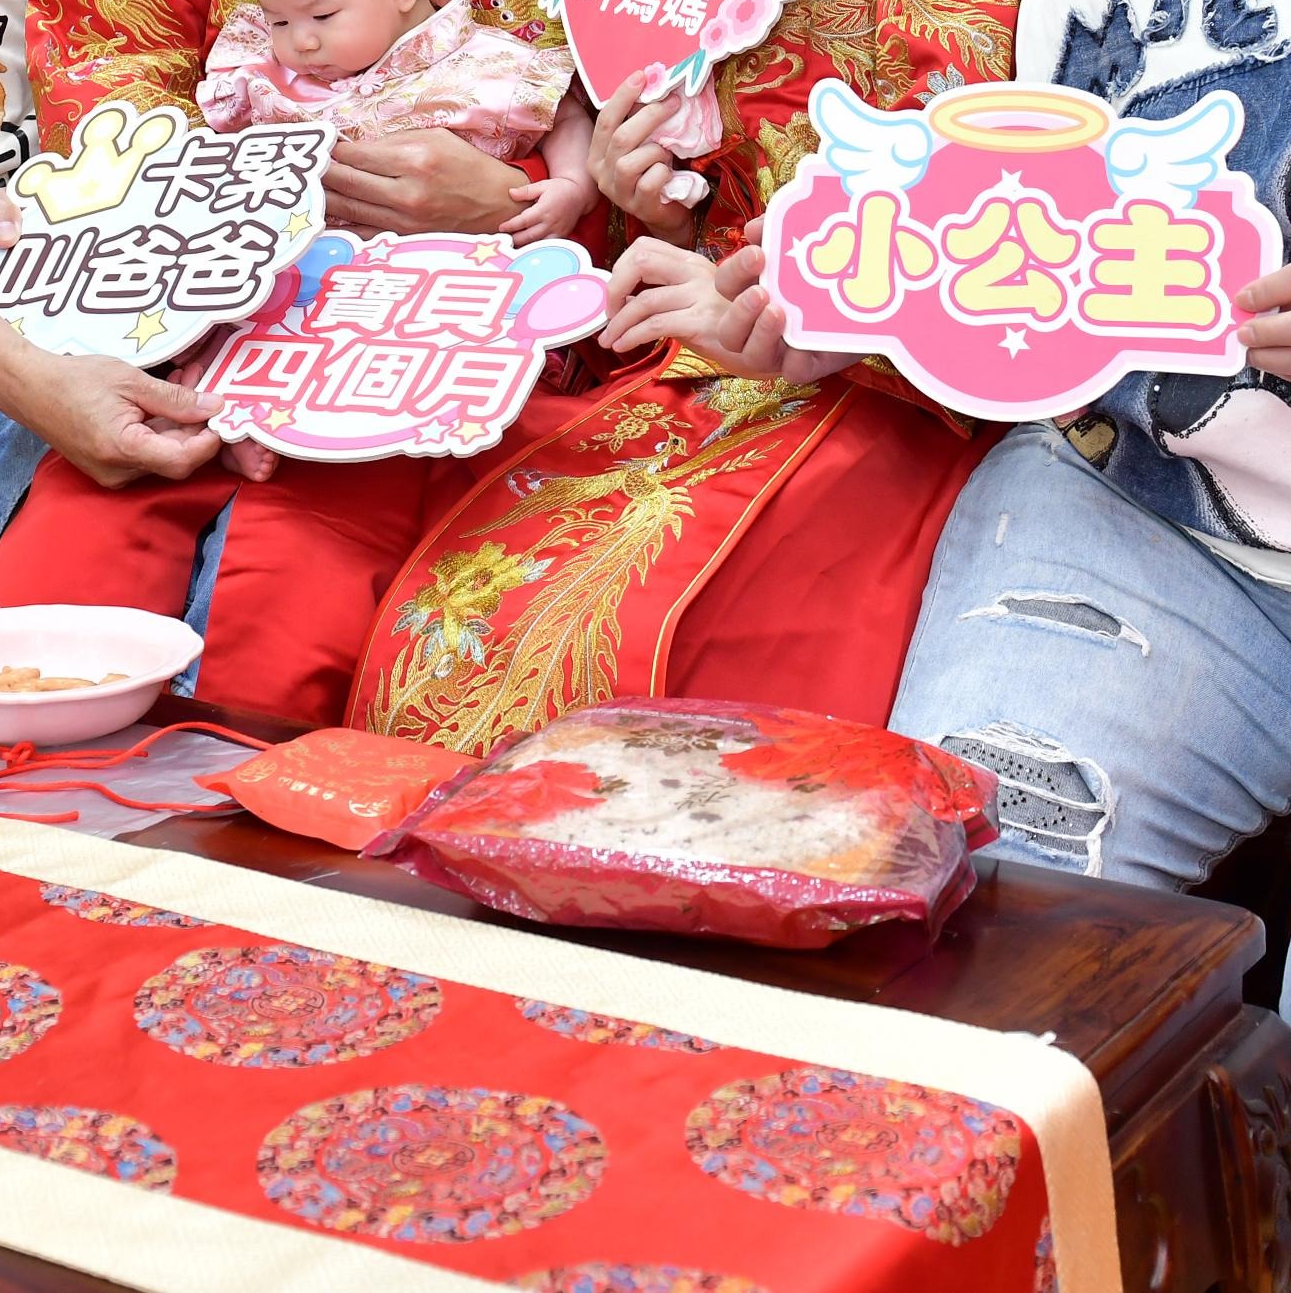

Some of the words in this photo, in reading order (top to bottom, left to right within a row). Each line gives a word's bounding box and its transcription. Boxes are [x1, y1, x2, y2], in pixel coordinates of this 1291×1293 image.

[142, 129, 326, 218] 卡緊
[304, 266, 521, 342] 寶貝
[807, 193, 1220, 328] 小公主
[211, 335, 533, 422] 四個月
